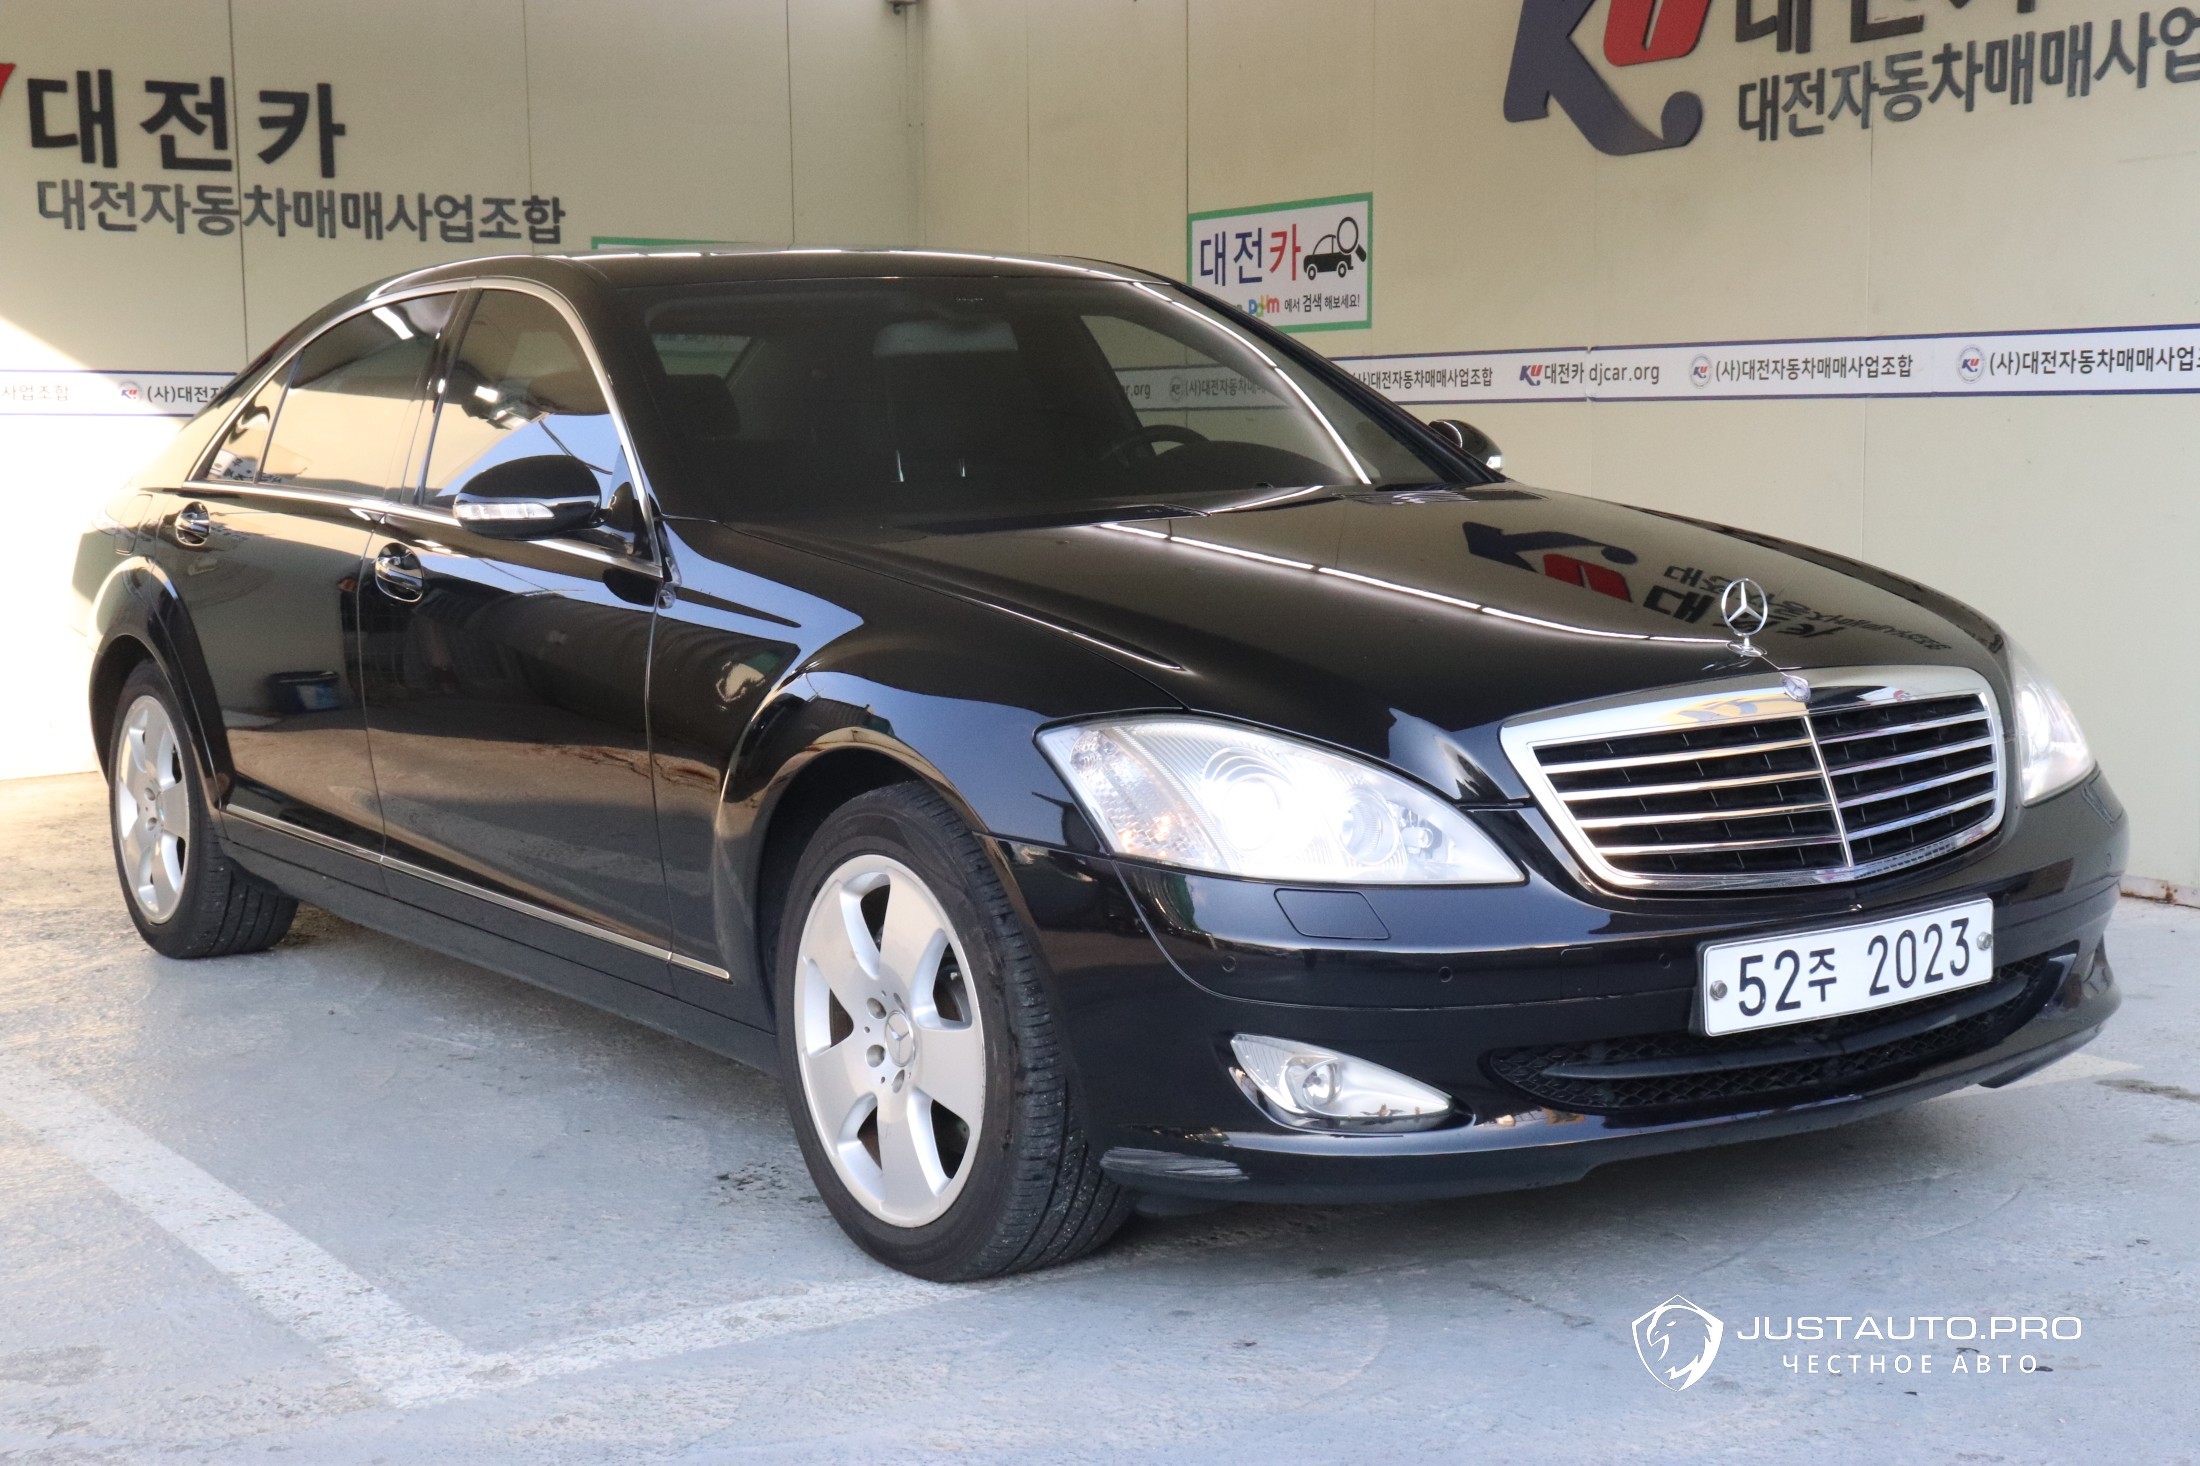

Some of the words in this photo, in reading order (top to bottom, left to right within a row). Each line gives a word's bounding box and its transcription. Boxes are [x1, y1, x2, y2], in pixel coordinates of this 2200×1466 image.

[27, 69, 346, 178] 대전카
[37, 178, 566, 245] 대전자동차매매사업조합
[1200, 223, 1302, 286] 대전카
[1284, 298, 1300, 313] 에서
[1302, 293, 1322, 313] 검색
[1324, 294, 1360, 310] 해보세요!
[1544, 362, 1585, 384] 대전카
[1589, 362, 1660, 386] djcar.org
[1716, 354, 1913, 382] (사)대전자동차매매사업조합
[1990, 346, 2200, 376] (사)대전자동차매매사업
[1352, 367, 1493, 389] )대전자동차매매사업조합
[1738, 948, 1837, 1017] 52주
[1867, 917, 1970, 997] 2023
